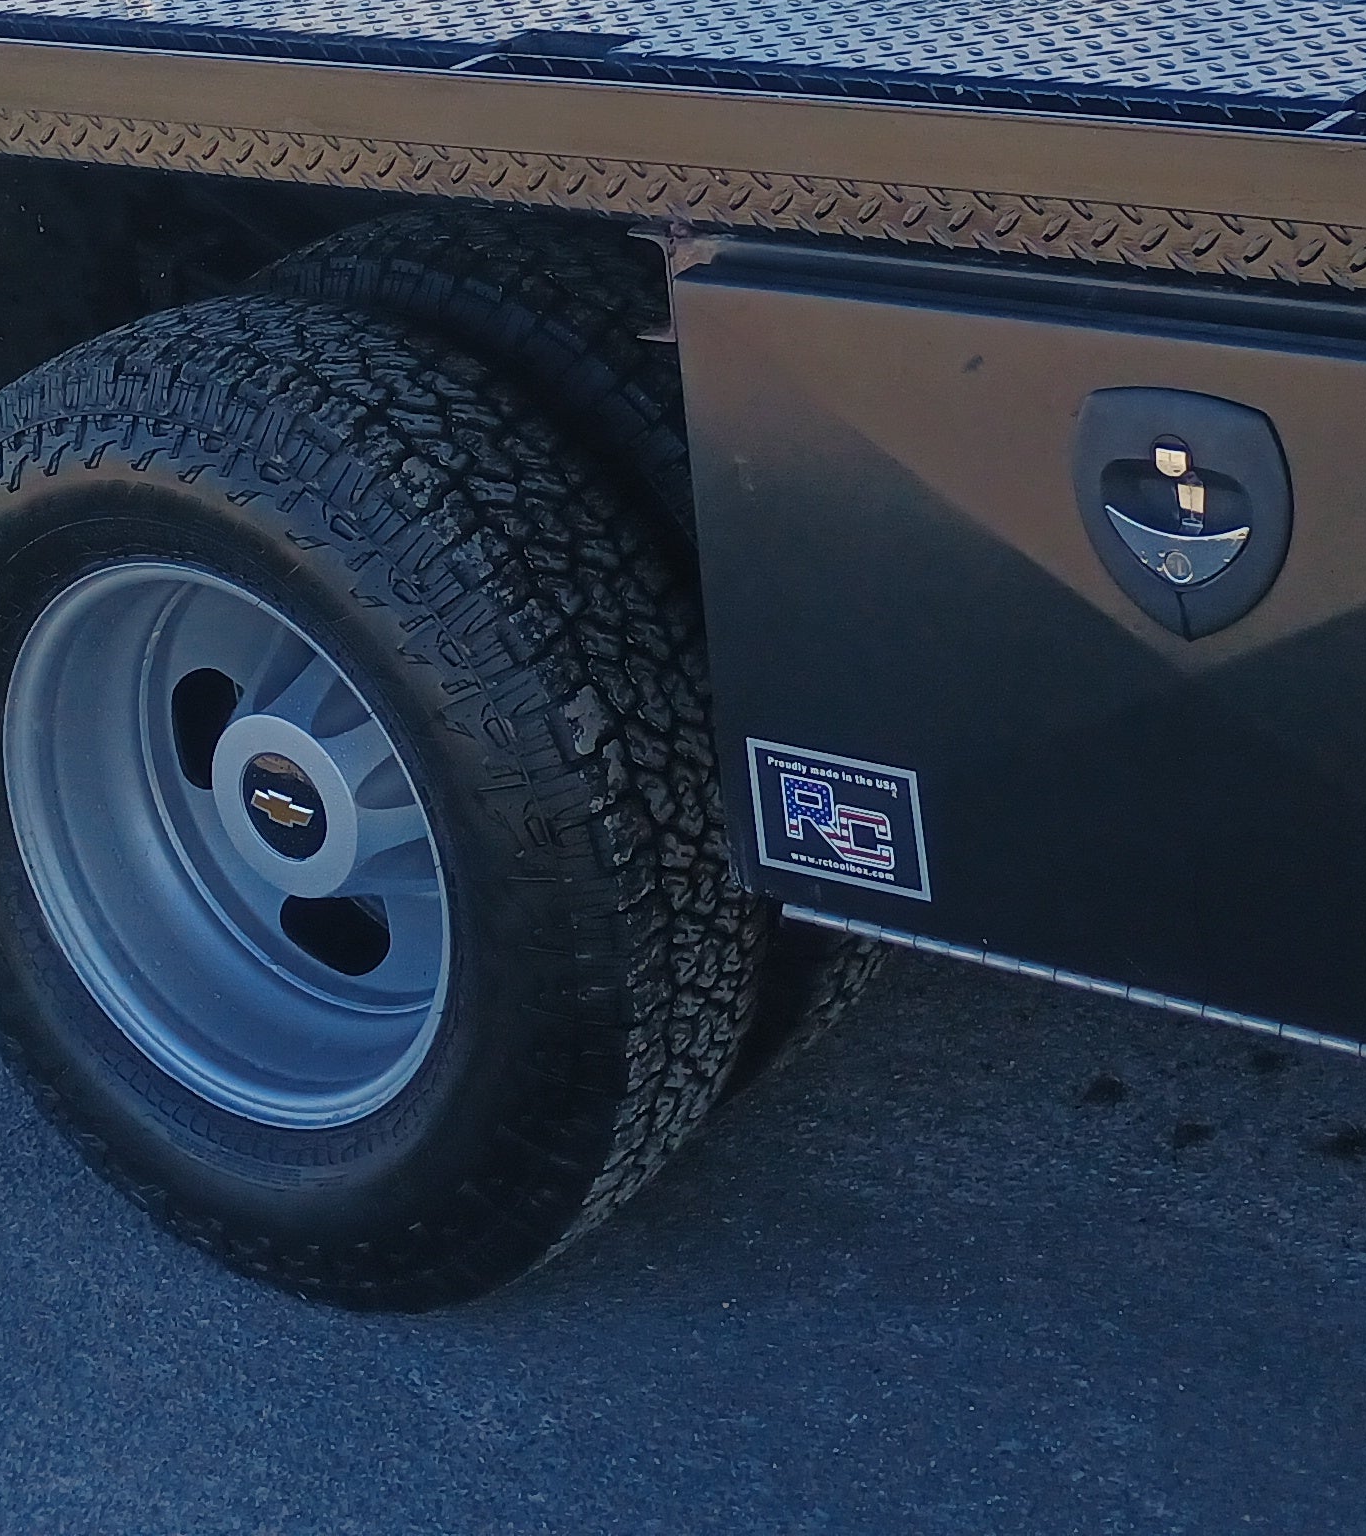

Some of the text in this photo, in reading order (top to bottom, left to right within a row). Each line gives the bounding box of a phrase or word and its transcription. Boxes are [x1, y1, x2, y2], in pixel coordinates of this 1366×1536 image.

[767, 755, 898, 793] Proudly made in the USA
[780, 772, 895, 870] RC
[790, 852, 895, 881] www.rctoolbox.com
